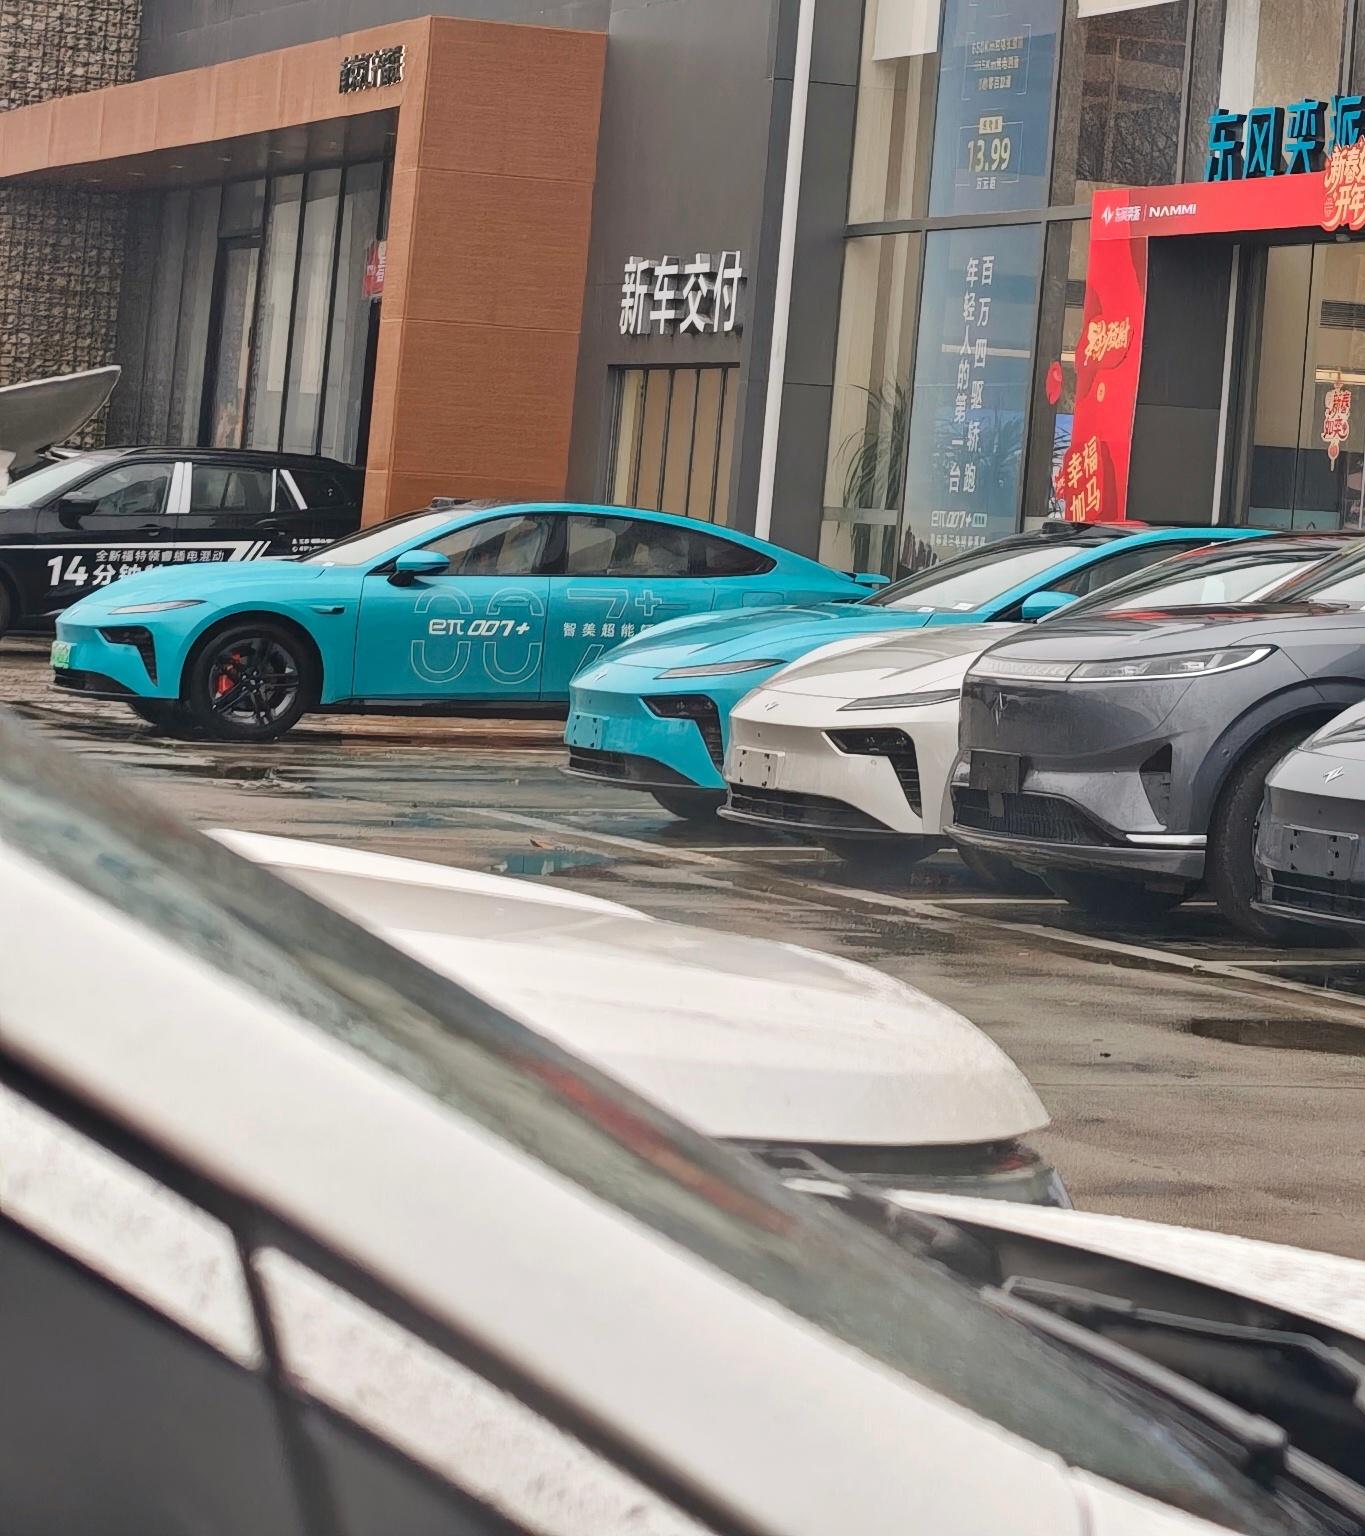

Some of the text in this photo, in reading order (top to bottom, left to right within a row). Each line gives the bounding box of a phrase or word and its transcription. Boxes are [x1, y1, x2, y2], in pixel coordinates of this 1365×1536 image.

[968, 137, 1011, 173] 13.99
[1149, 204, 1196, 218] NAMMI
[619, 250, 744, 335] 新车交付
[949, 257, 979, 494] 年轻人的第一台
[963, 255, 995, 493] 百万四驱轿跑
[1067, 436, 1099, 489] 幸福
